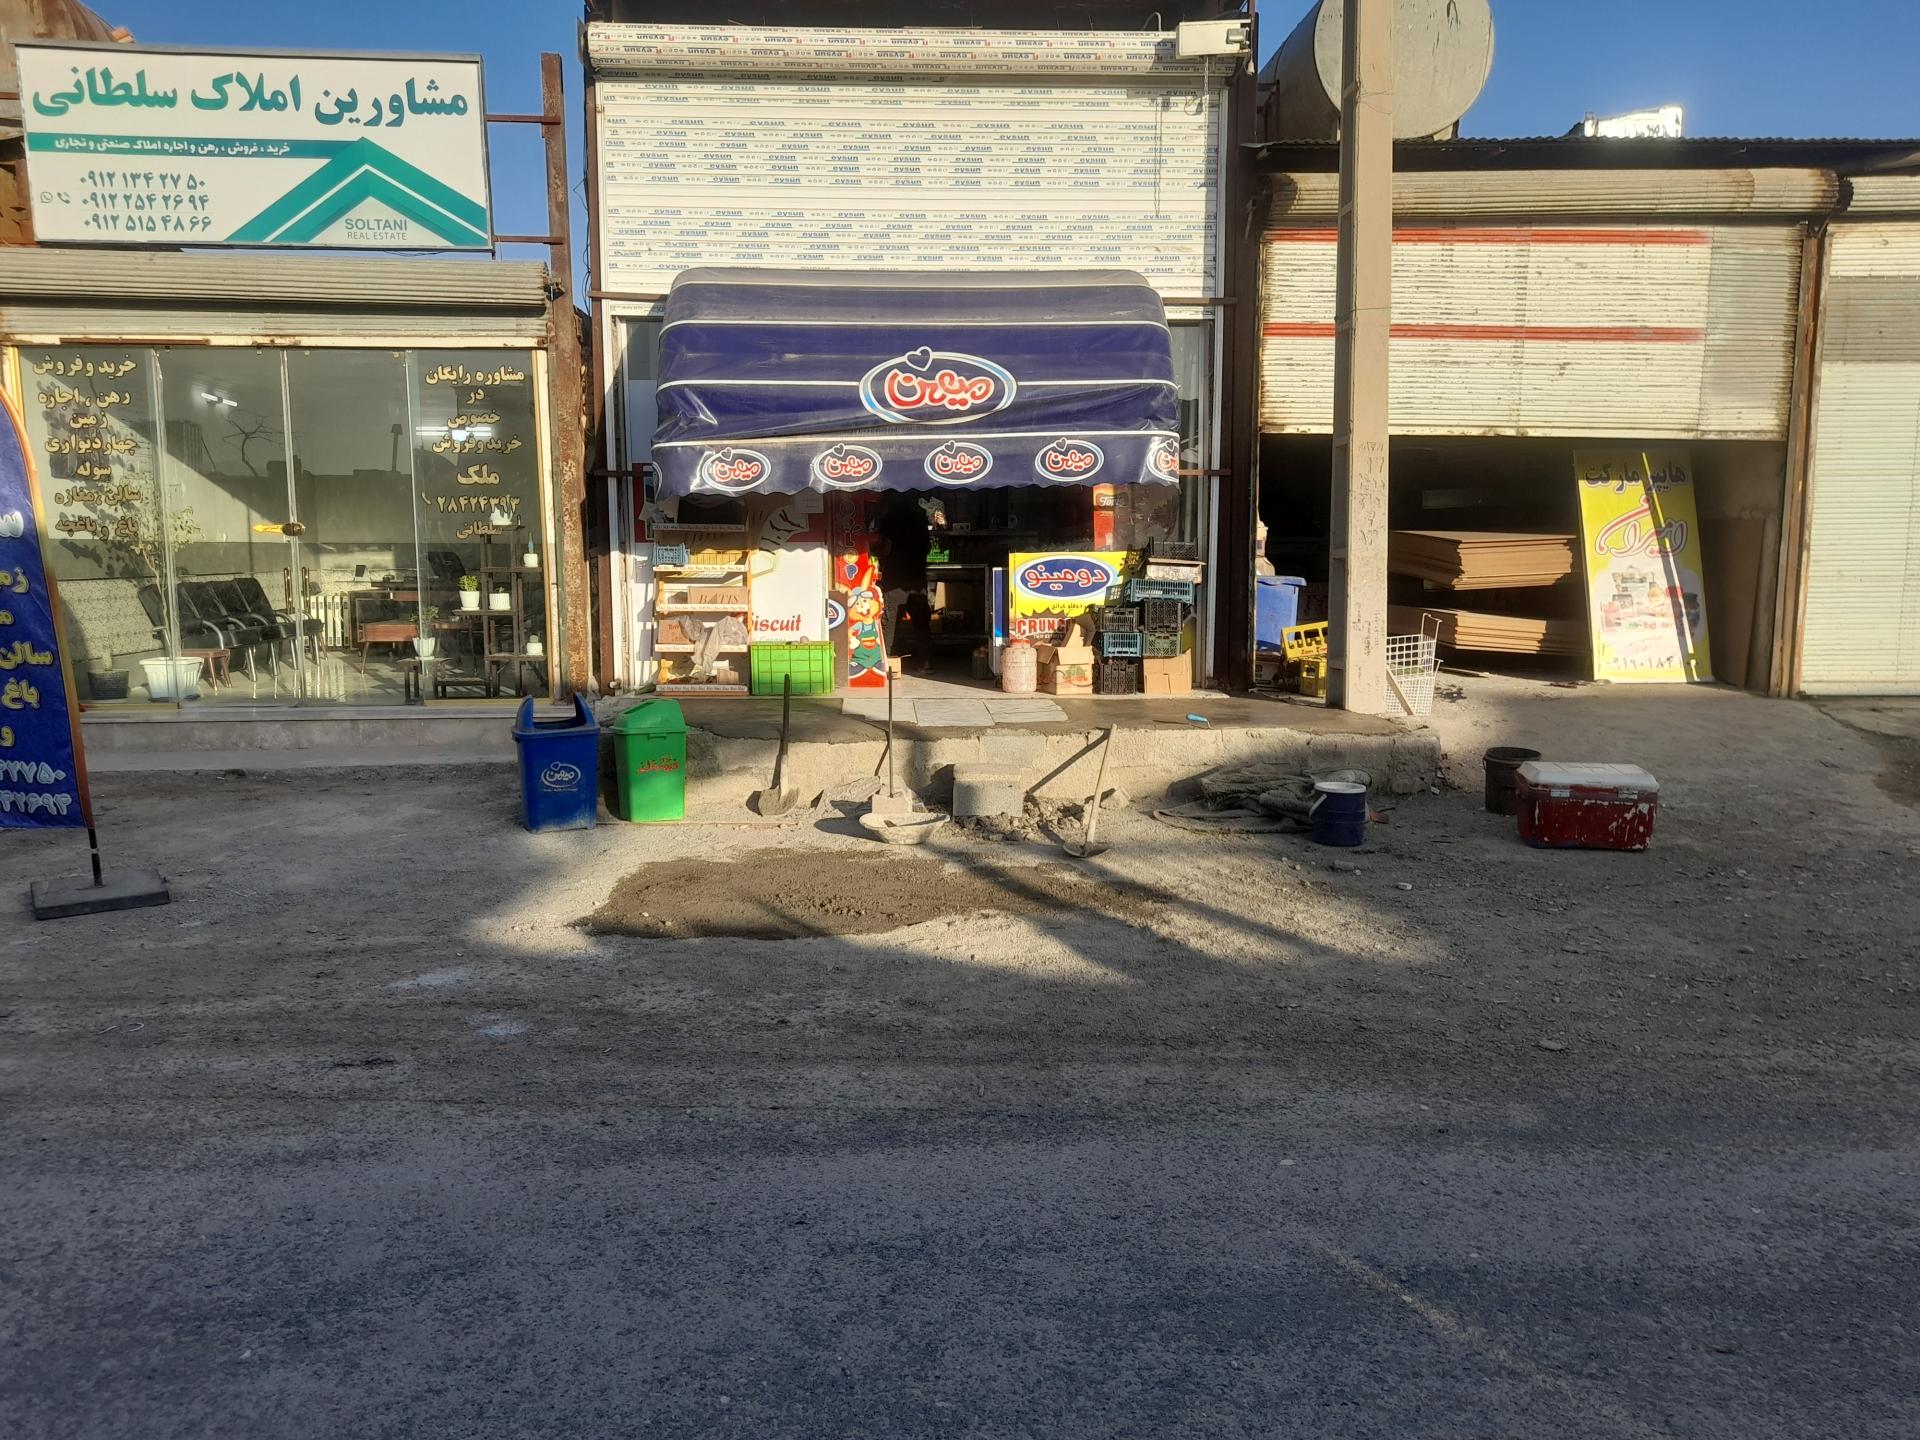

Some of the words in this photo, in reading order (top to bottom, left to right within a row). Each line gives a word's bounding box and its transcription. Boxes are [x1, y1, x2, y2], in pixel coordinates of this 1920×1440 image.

[33, 67, 178, 117] سلطانی
[191, 71, 301, 113] املاک
[315, 77, 468, 127] مشاورین
[55, 138, 88, 150] تجاری
[97, 139, 131, 151] صنعتی
[132, 140, 161, 150] املاک
[164, 142, 188, 154] اجاره
[198, 143, 219, 155] رهن
[228, 142, 258, 155] فروش
[266, 142, 290, 155] خرید
[345, 218, 408, 231] SOLTANI
[347, 232, 371, 240] REAL
[374, 232, 407, 240] ESTATE
[98, 353, 137, 379] خرید
[425, 364, 471, 385] رایگان
[476, 366, 525, 386] مشاوره
[466, 388, 485, 404] در
[884, 366, 994, 410] میهن
[96, 391, 131, 408] رهن
[69, 410, 108, 429] زمین
[447, 409, 501, 428] خصوص
[487, 434, 523, 454] خرید
[76, 461, 112, 480] سوله
[713, 459, 761, 482] میهن
[824, 456, 873, 478] میهن
[935, 452, 983, 474] میهن
[1046, 450, 1095, 471] میهن
[456, 464, 500, 485] ملک
[54, 486, 96, 507] مغازه
[104, 485, 141, 506] سالن
[55, 516, 97, 537] باغچه
[100, 525, 109, 541] و
[115, 516, 139, 537] باغ
[456, 520, 503, 539] سلطانی
[1024, 564, 1108, 590] دومینو
[1, 677, 40, 709] باغ
